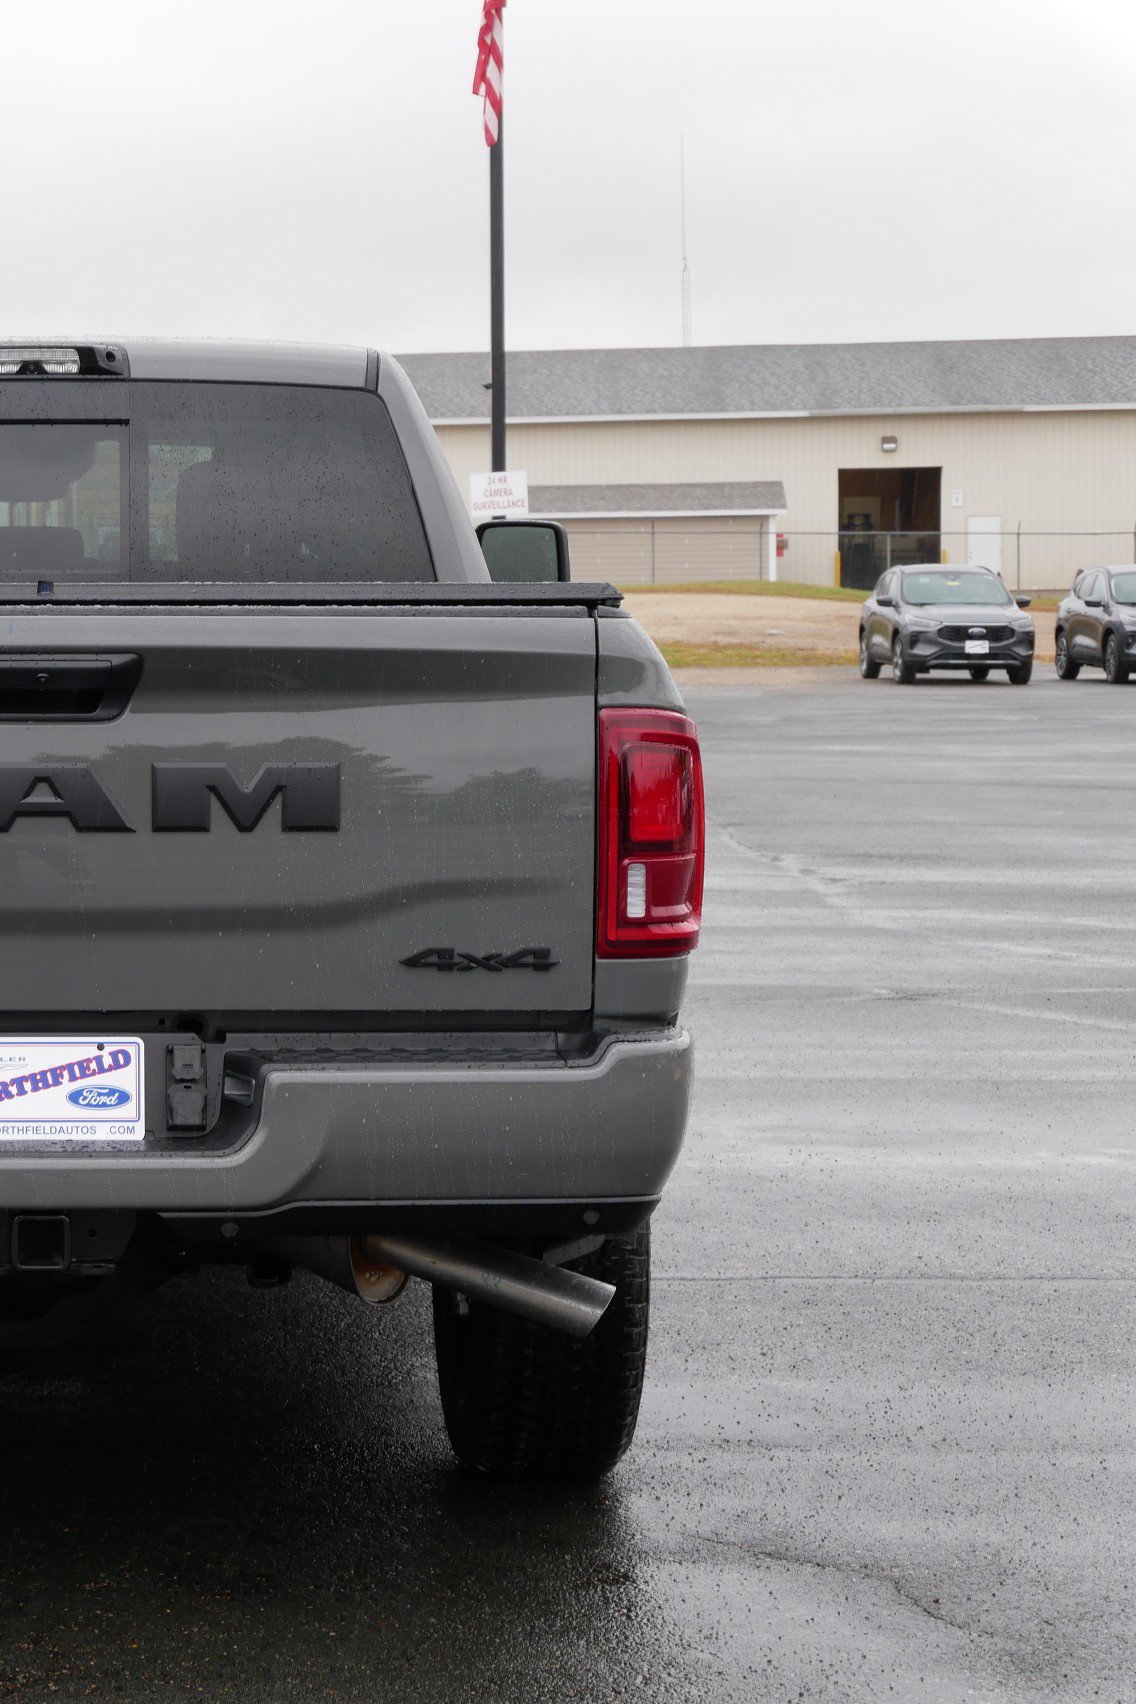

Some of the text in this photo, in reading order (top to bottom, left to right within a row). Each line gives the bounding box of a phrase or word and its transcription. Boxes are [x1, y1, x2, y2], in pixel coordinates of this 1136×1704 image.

[488, 475, 508, 485] 24 HR
[484, 488, 513, 498] CAMERA
[473, 499, 526, 511] SURVEILLANCE
[78, 1088, 118, 1105] Ford
